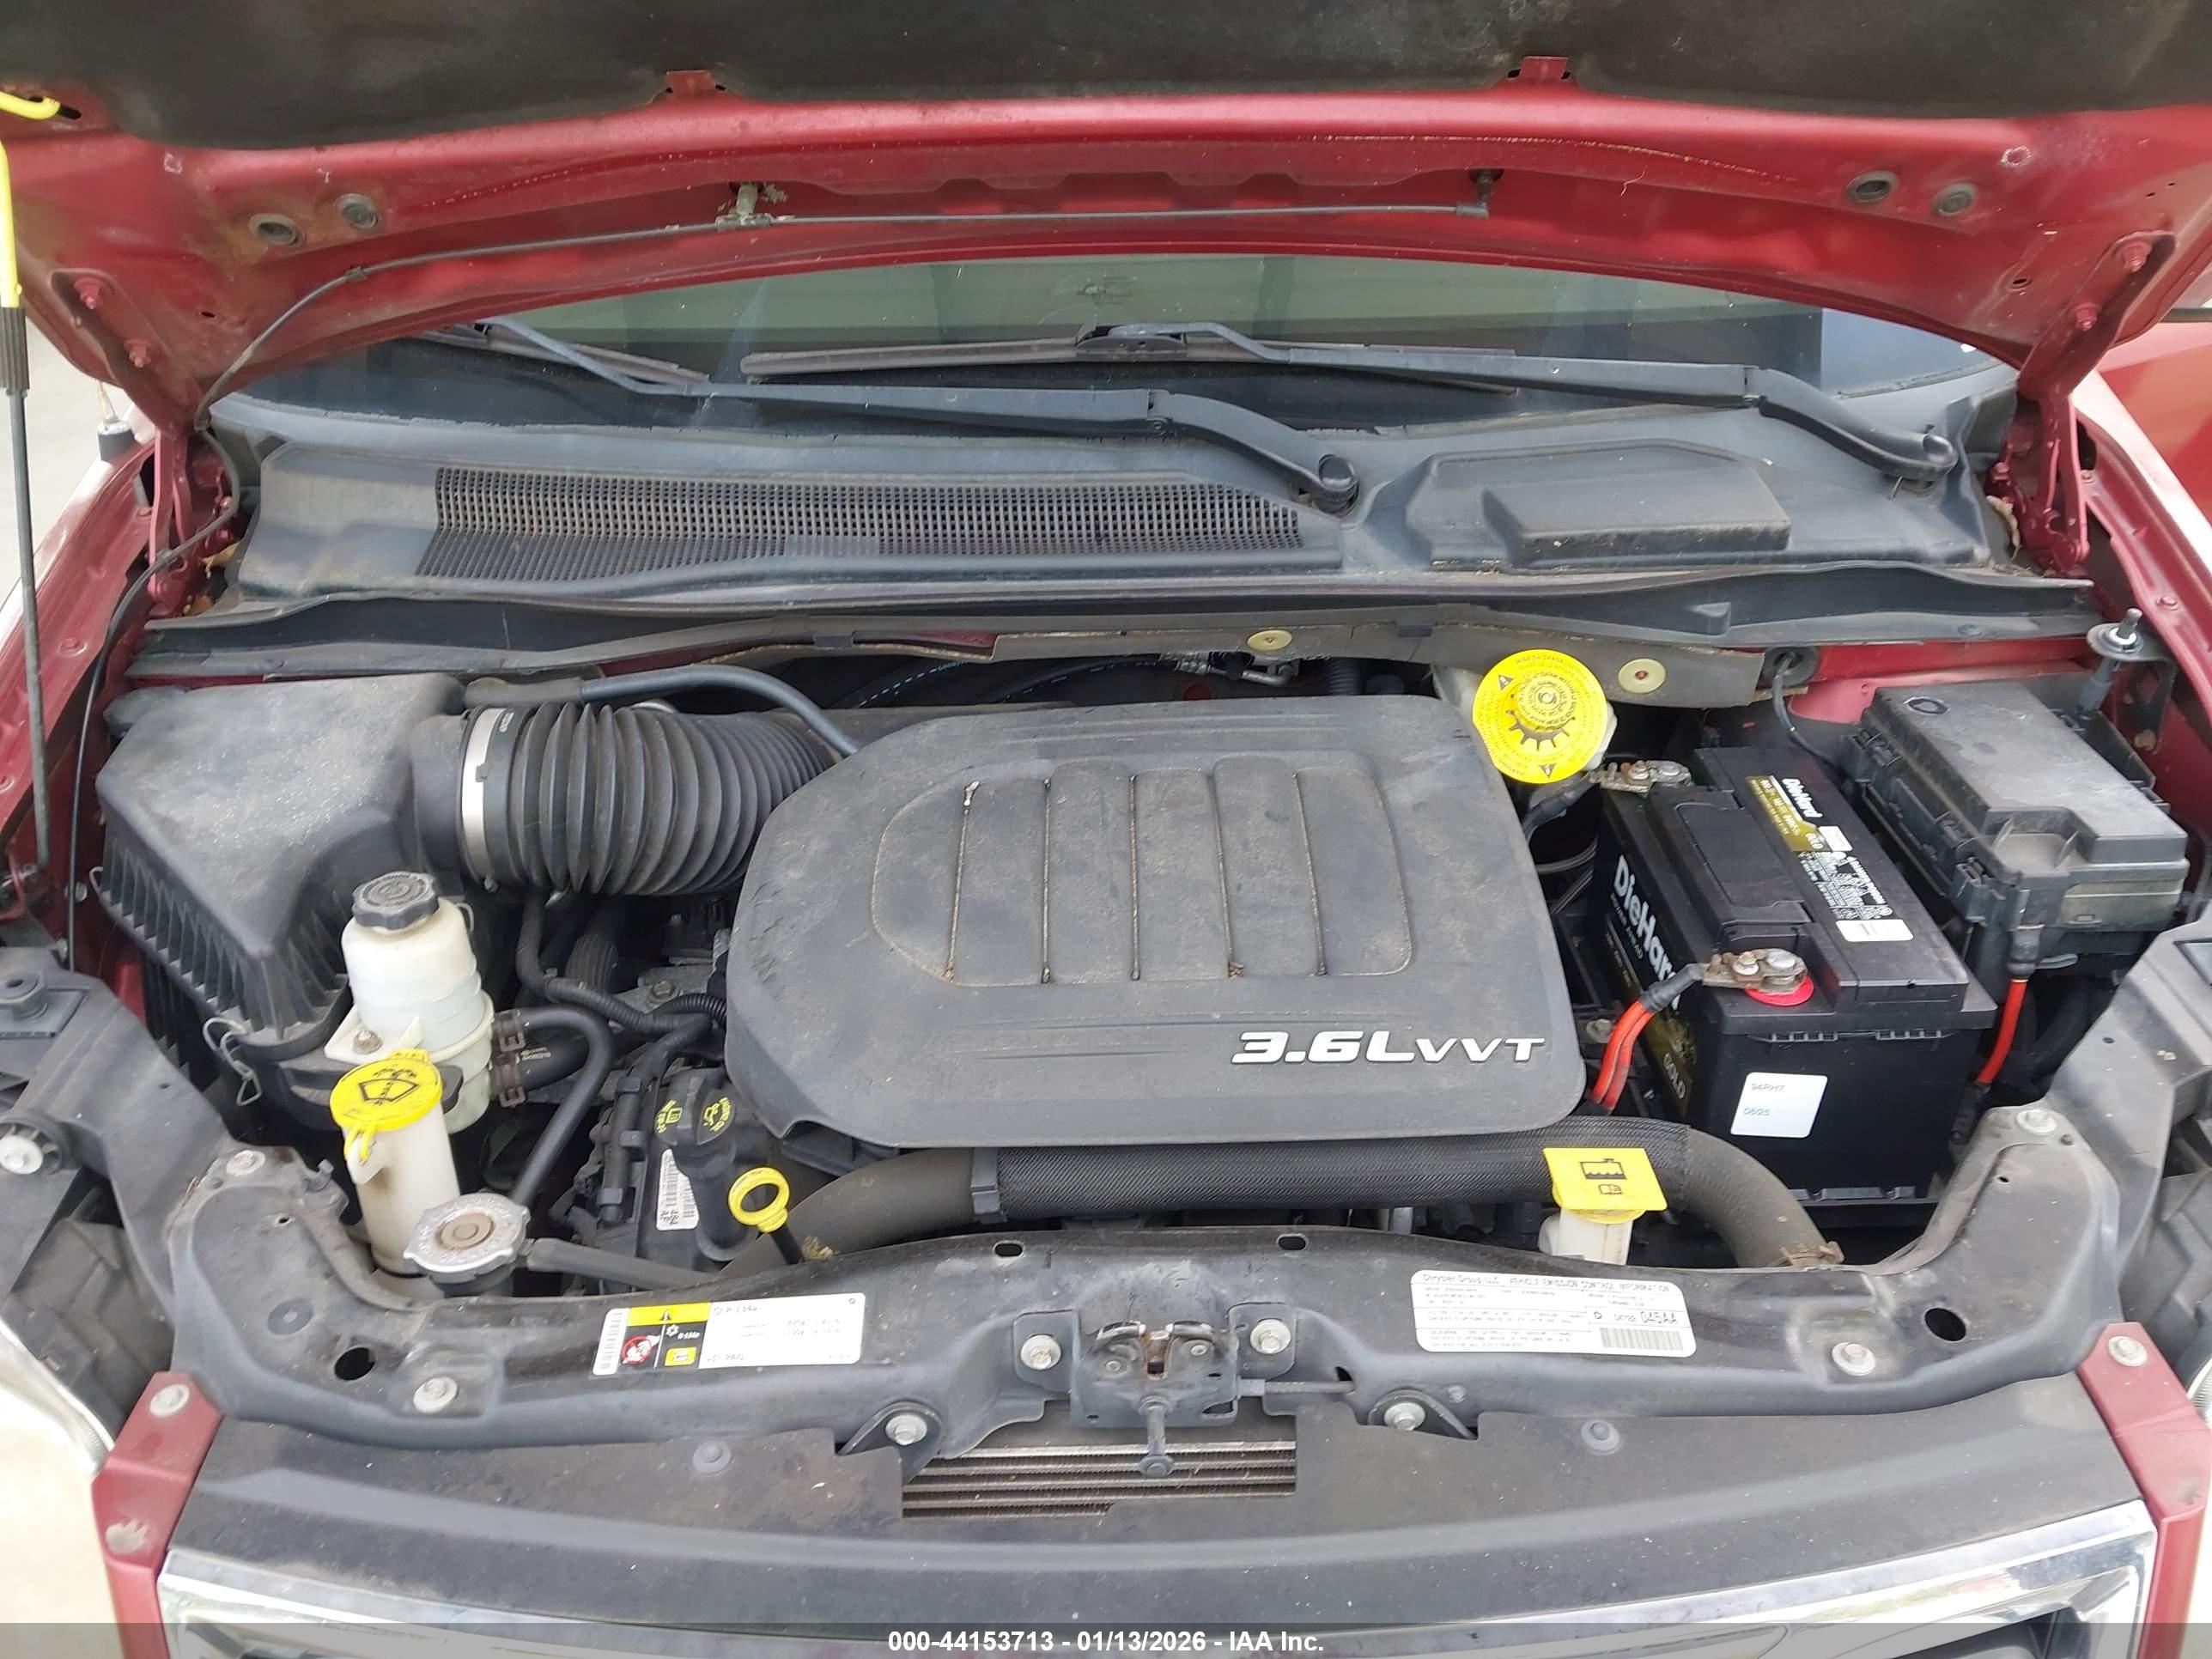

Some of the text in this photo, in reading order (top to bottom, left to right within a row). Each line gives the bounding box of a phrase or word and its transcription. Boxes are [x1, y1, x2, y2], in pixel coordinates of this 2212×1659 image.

[1781, 778, 1823, 818] DieHard
[1613, 854, 1680, 1011] DieHar
[1663, 1053, 1686, 1099] GOLD
